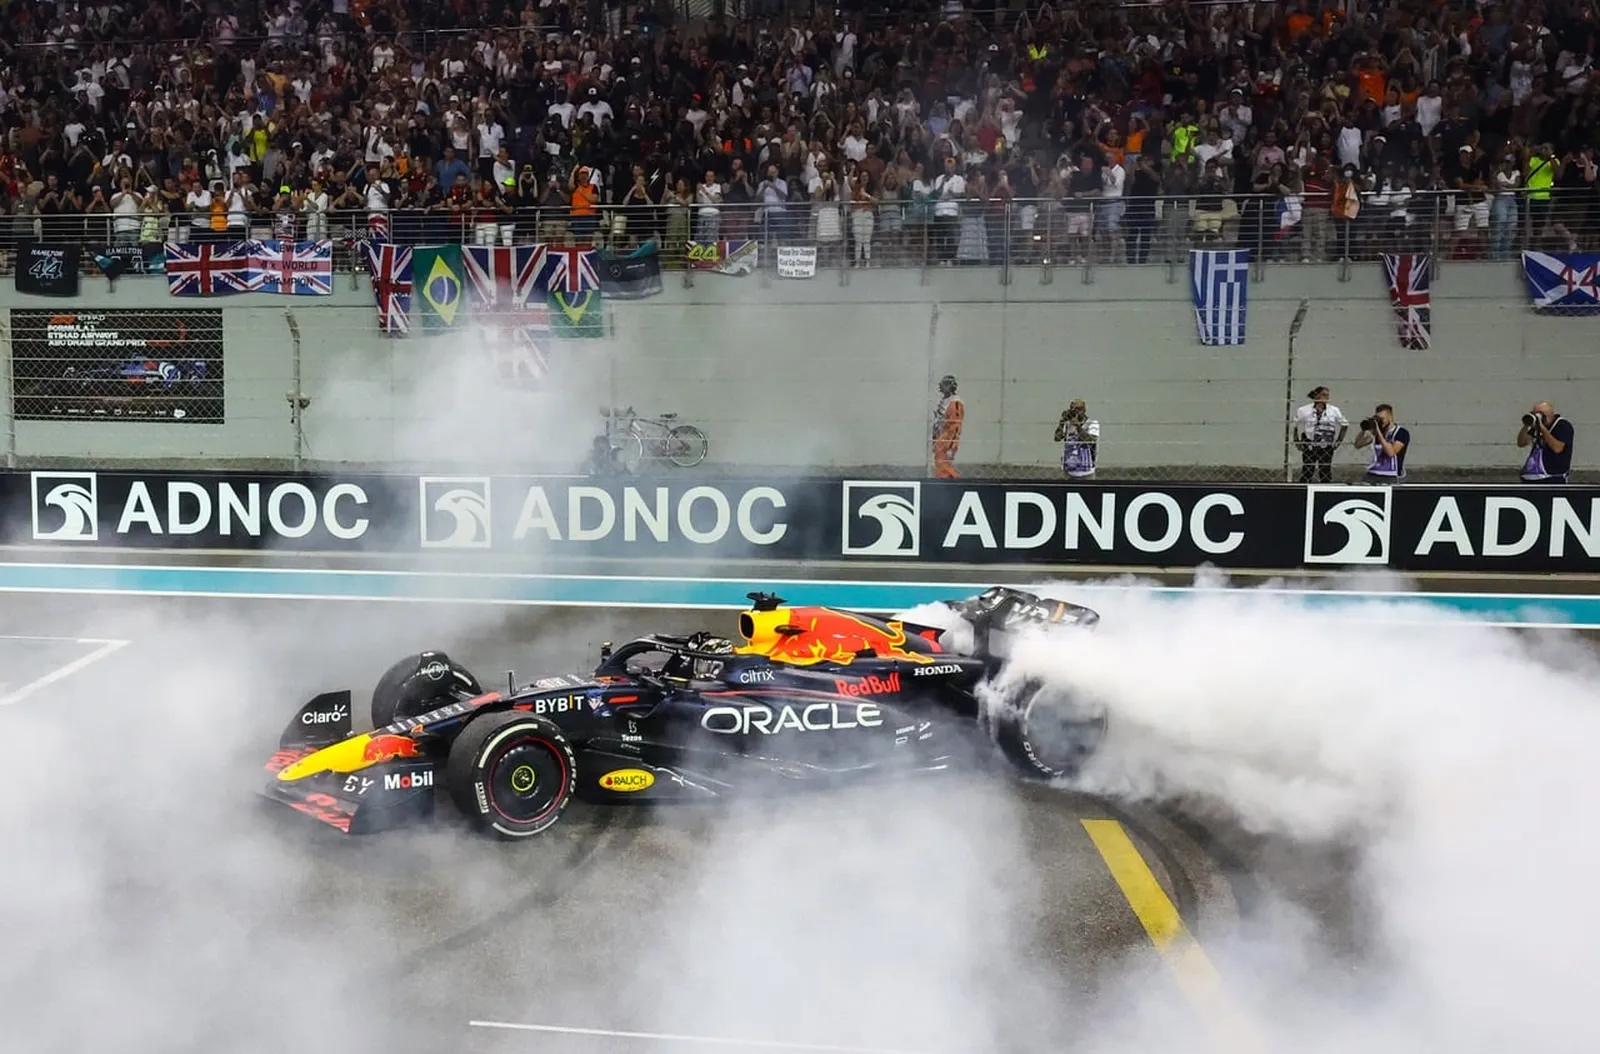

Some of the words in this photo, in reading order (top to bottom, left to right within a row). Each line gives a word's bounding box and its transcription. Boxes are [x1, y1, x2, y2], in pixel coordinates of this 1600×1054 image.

[105, 247, 143, 256] HAMILTON
[28, 258, 65, 279] 44
[281, 261, 318, 271] WORLD
[1560, 264, 1599, 299] 44
[117, 481, 369, 538] ADNOC
[513, 486, 787, 544] ADNOC
[943, 491, 1246, 554] ADNOC
[739, 669, 775, 684] citrix
[913, 664, 963, 677] HONDA
[535, 694, 584, 714] BYBIT
[302, 709, 345, 725] Claro
[701, 702, 884, 736] ORACLE
[384, 771, 433, 790] Mobil
[614, 775, 647, 786] RAUCH
